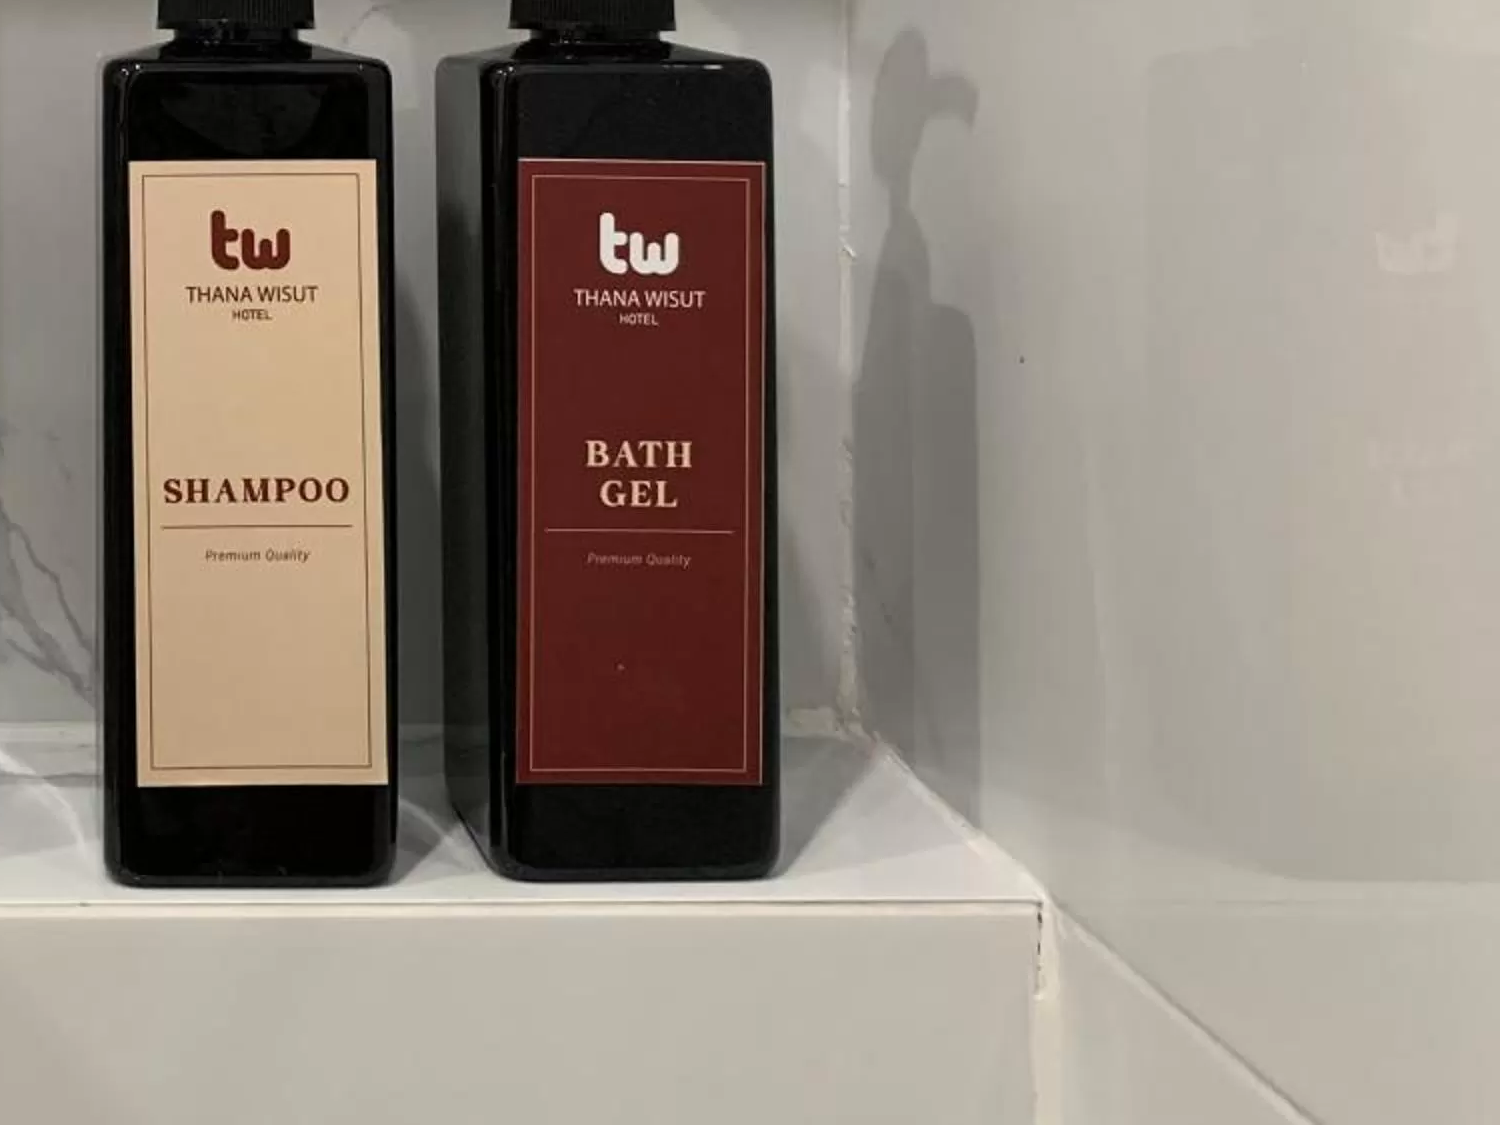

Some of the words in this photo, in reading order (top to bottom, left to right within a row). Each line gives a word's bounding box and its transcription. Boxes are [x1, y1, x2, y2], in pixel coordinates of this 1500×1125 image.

[210, 209, 291, 271] tw
[599, 212, 680, 275] tw
[184, 285, 254, 303] THANA
[257, 285, 319, 303] WISUT
[573, 288, 641, 307] THANA
[643, 289, 707, 308] WISUT
[232, 308, 273, 321] HOTEL
[619, 312, 659, 326] HOTEL
[584, 439, 693, 468] BATH
[162, 477, 350, 504] SHAMPOO
[599, 479, 678, 508] GEL
[205, 548, 261, 562] Premium
[265, 548, 311, 564] Quality
[586, 551, 643, 565] Premium
[645, 552, 692, 570] Quality
